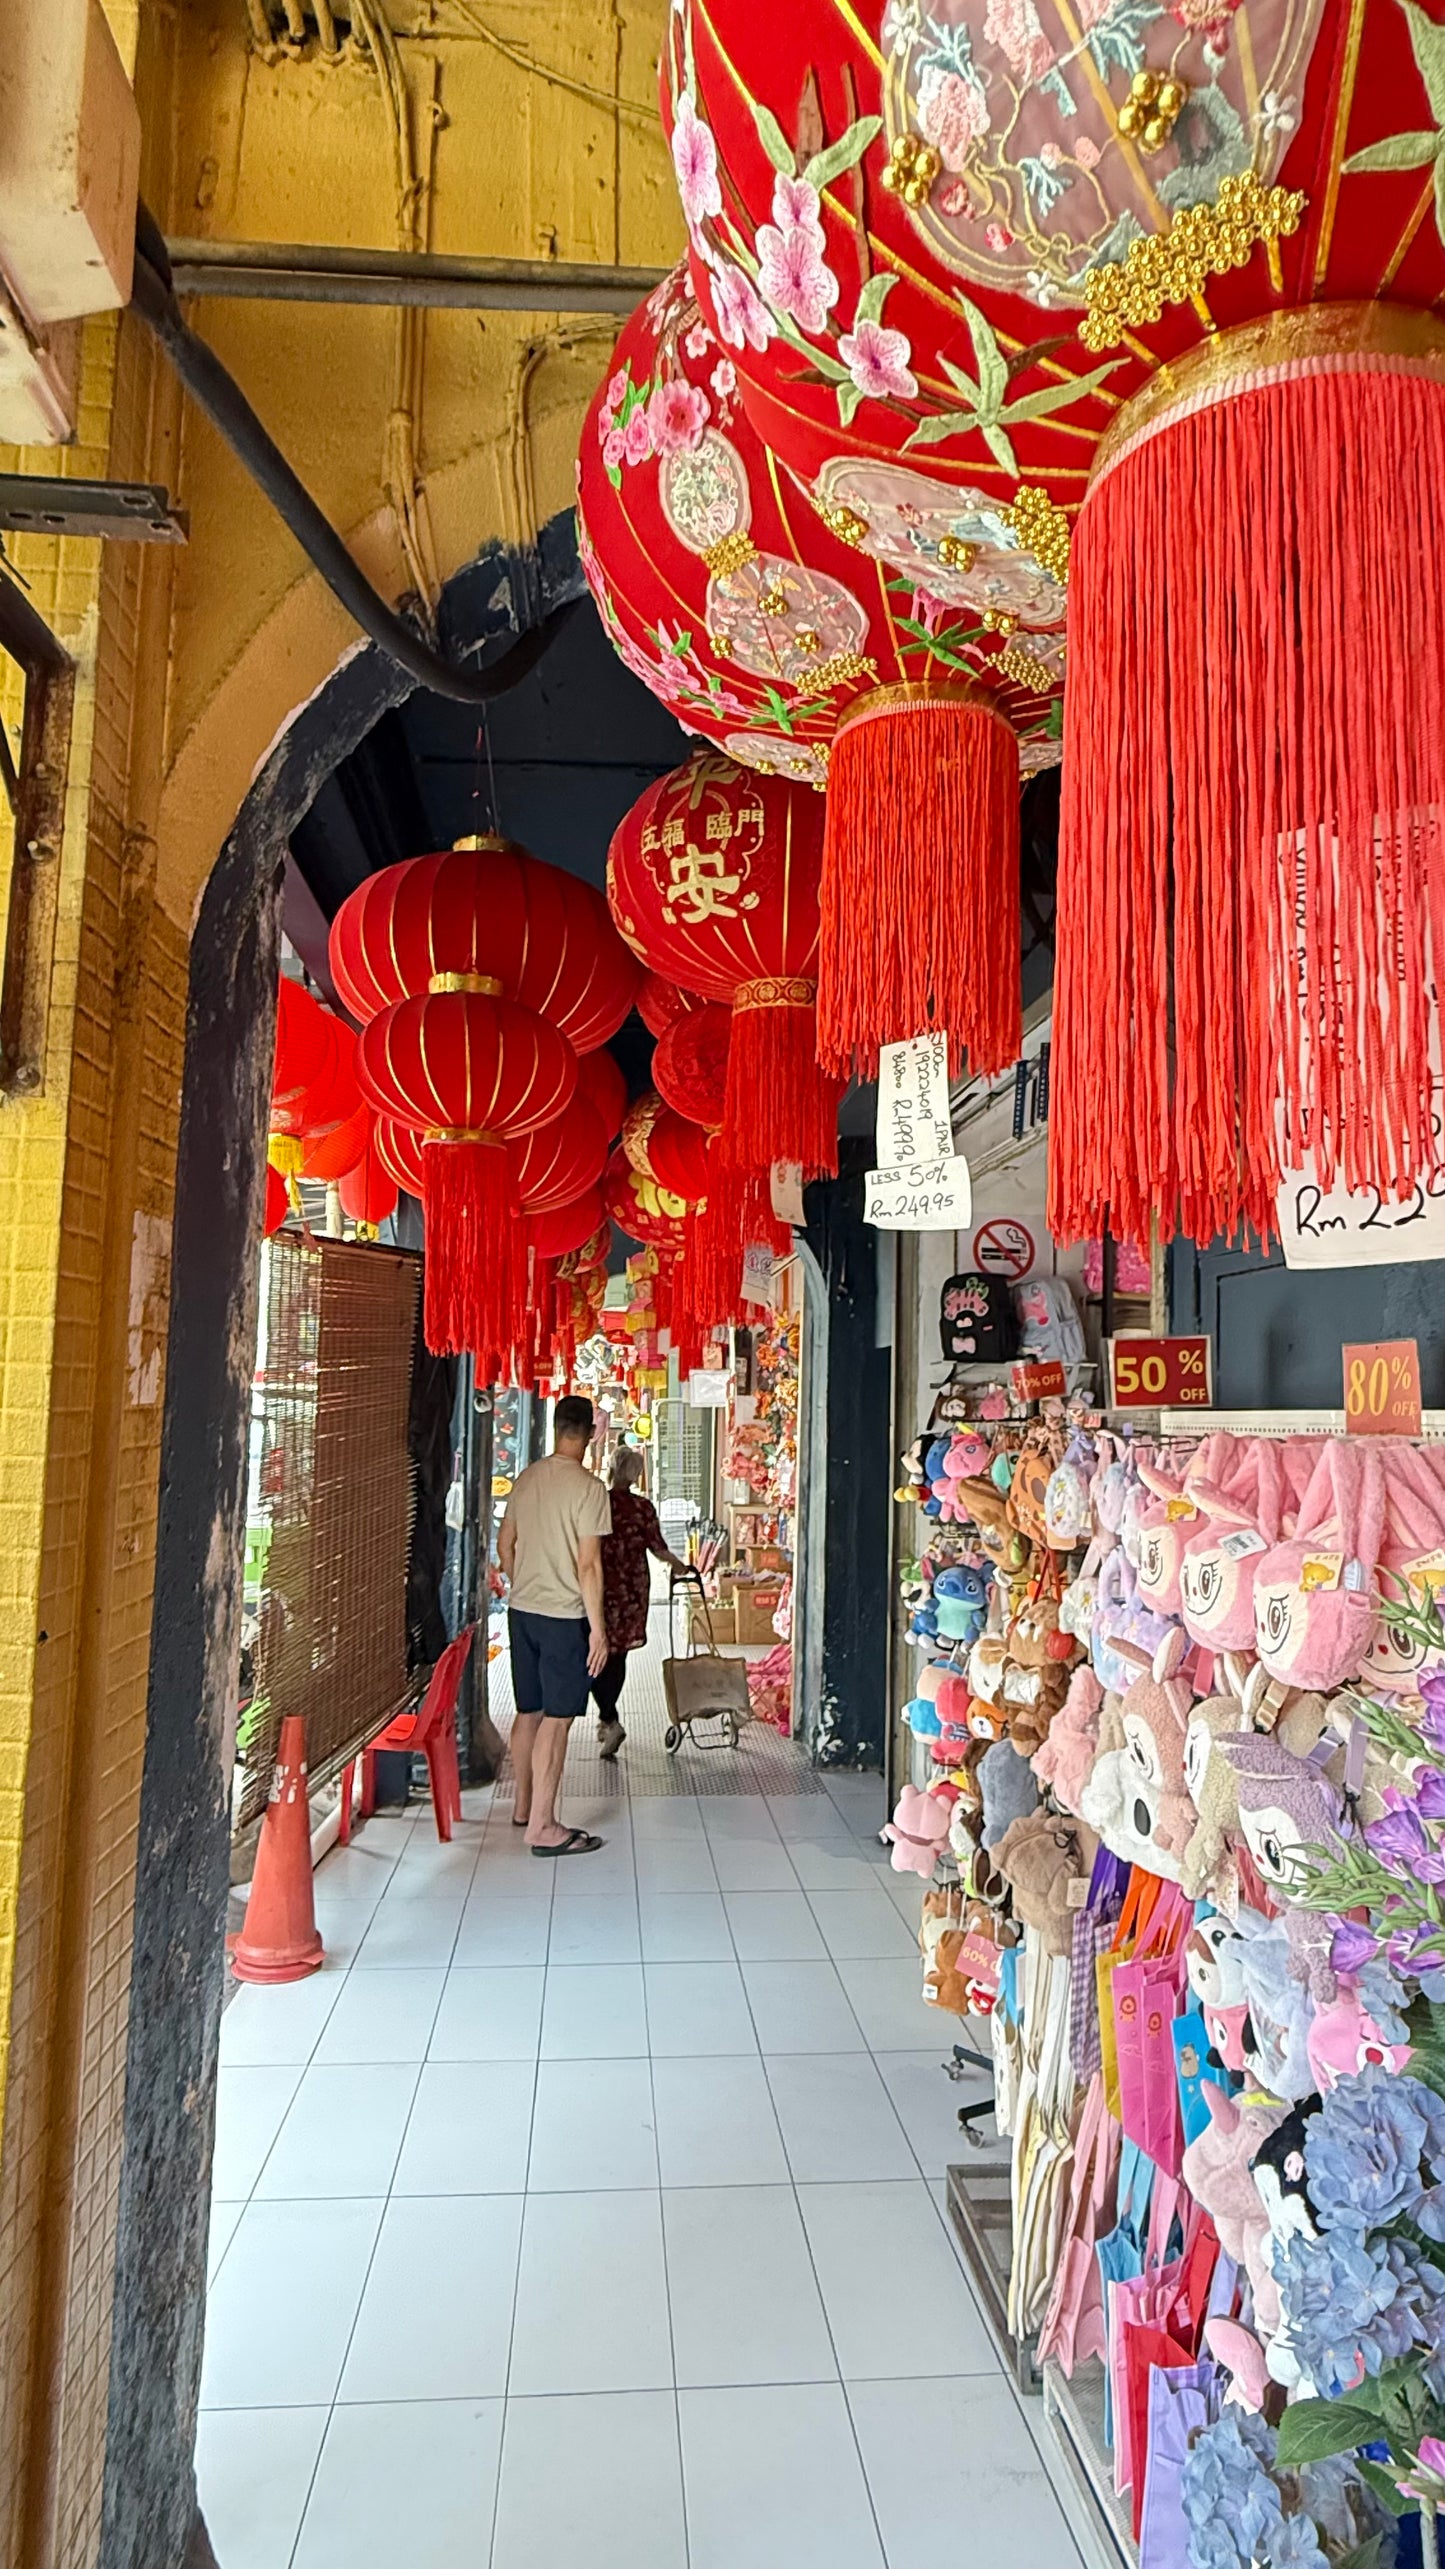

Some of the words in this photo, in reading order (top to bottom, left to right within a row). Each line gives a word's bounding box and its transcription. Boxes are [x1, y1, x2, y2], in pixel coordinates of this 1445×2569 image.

[871, 1171, 901, 1185] LESS
[907, 1161, 948, 1187] 50%
[1041, 1373, 1062, 1386] OFF
[1179, 1388, 1206, 1401] OFF
[1391, 1400, 1418, 1417] OFF
[962, 1946, 989, 1969] 60%
